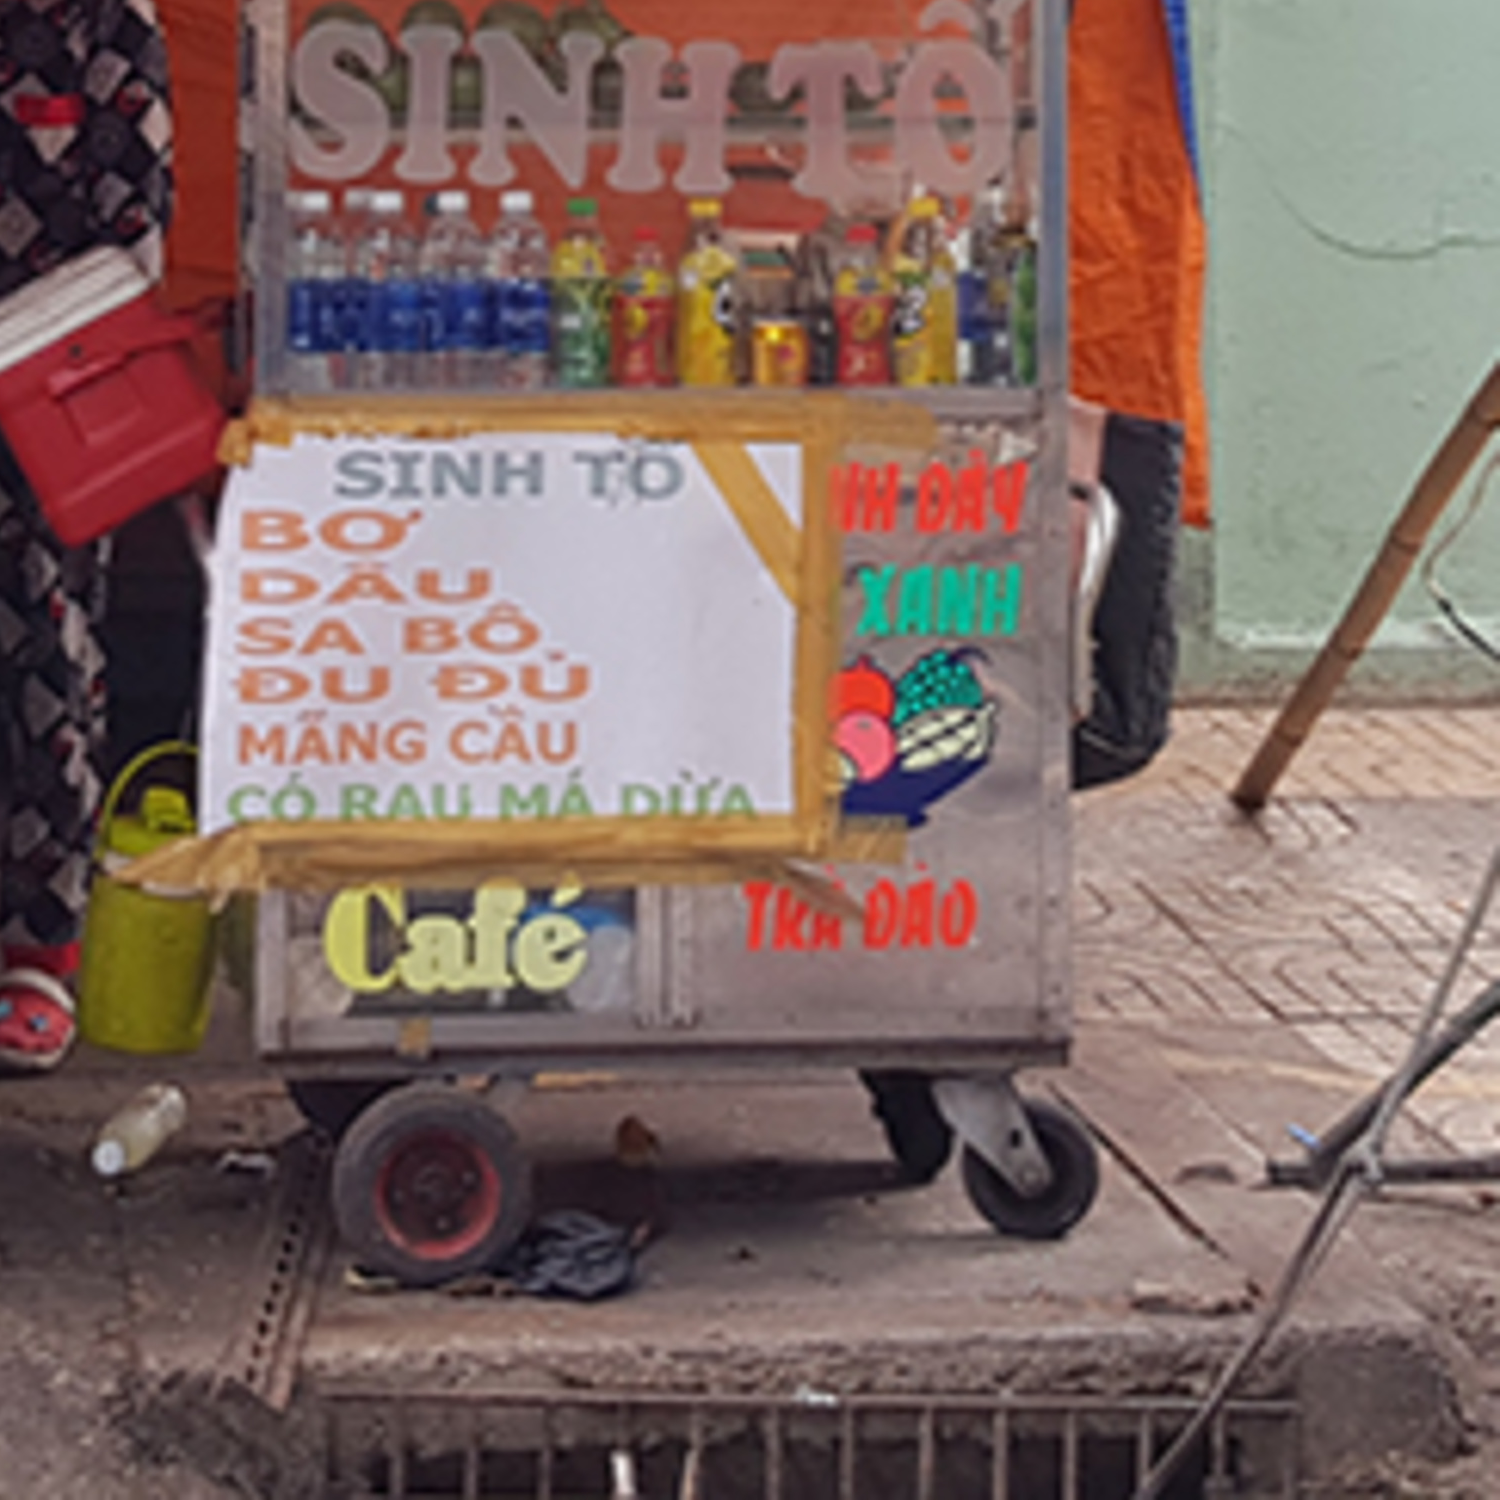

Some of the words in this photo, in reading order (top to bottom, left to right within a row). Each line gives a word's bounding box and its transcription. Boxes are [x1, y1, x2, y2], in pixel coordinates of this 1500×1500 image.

[288, 18, 742, 195] SINH
[333, 449, 546, 501] SINH
[240, 507, 425, 554] BƠ
[856, 562, 1024, 638] XANH
[234, 614, 367, 657] SA
[229, 662, 393, 705] ĐU
[226, 770, 318, 822] CÓ
[340, 782, 474, 822] RAU
[499, 765, 595, 822] MÁ
[619, 765, 759, 822] DỪA
[323, 871, 588, 994] Café
